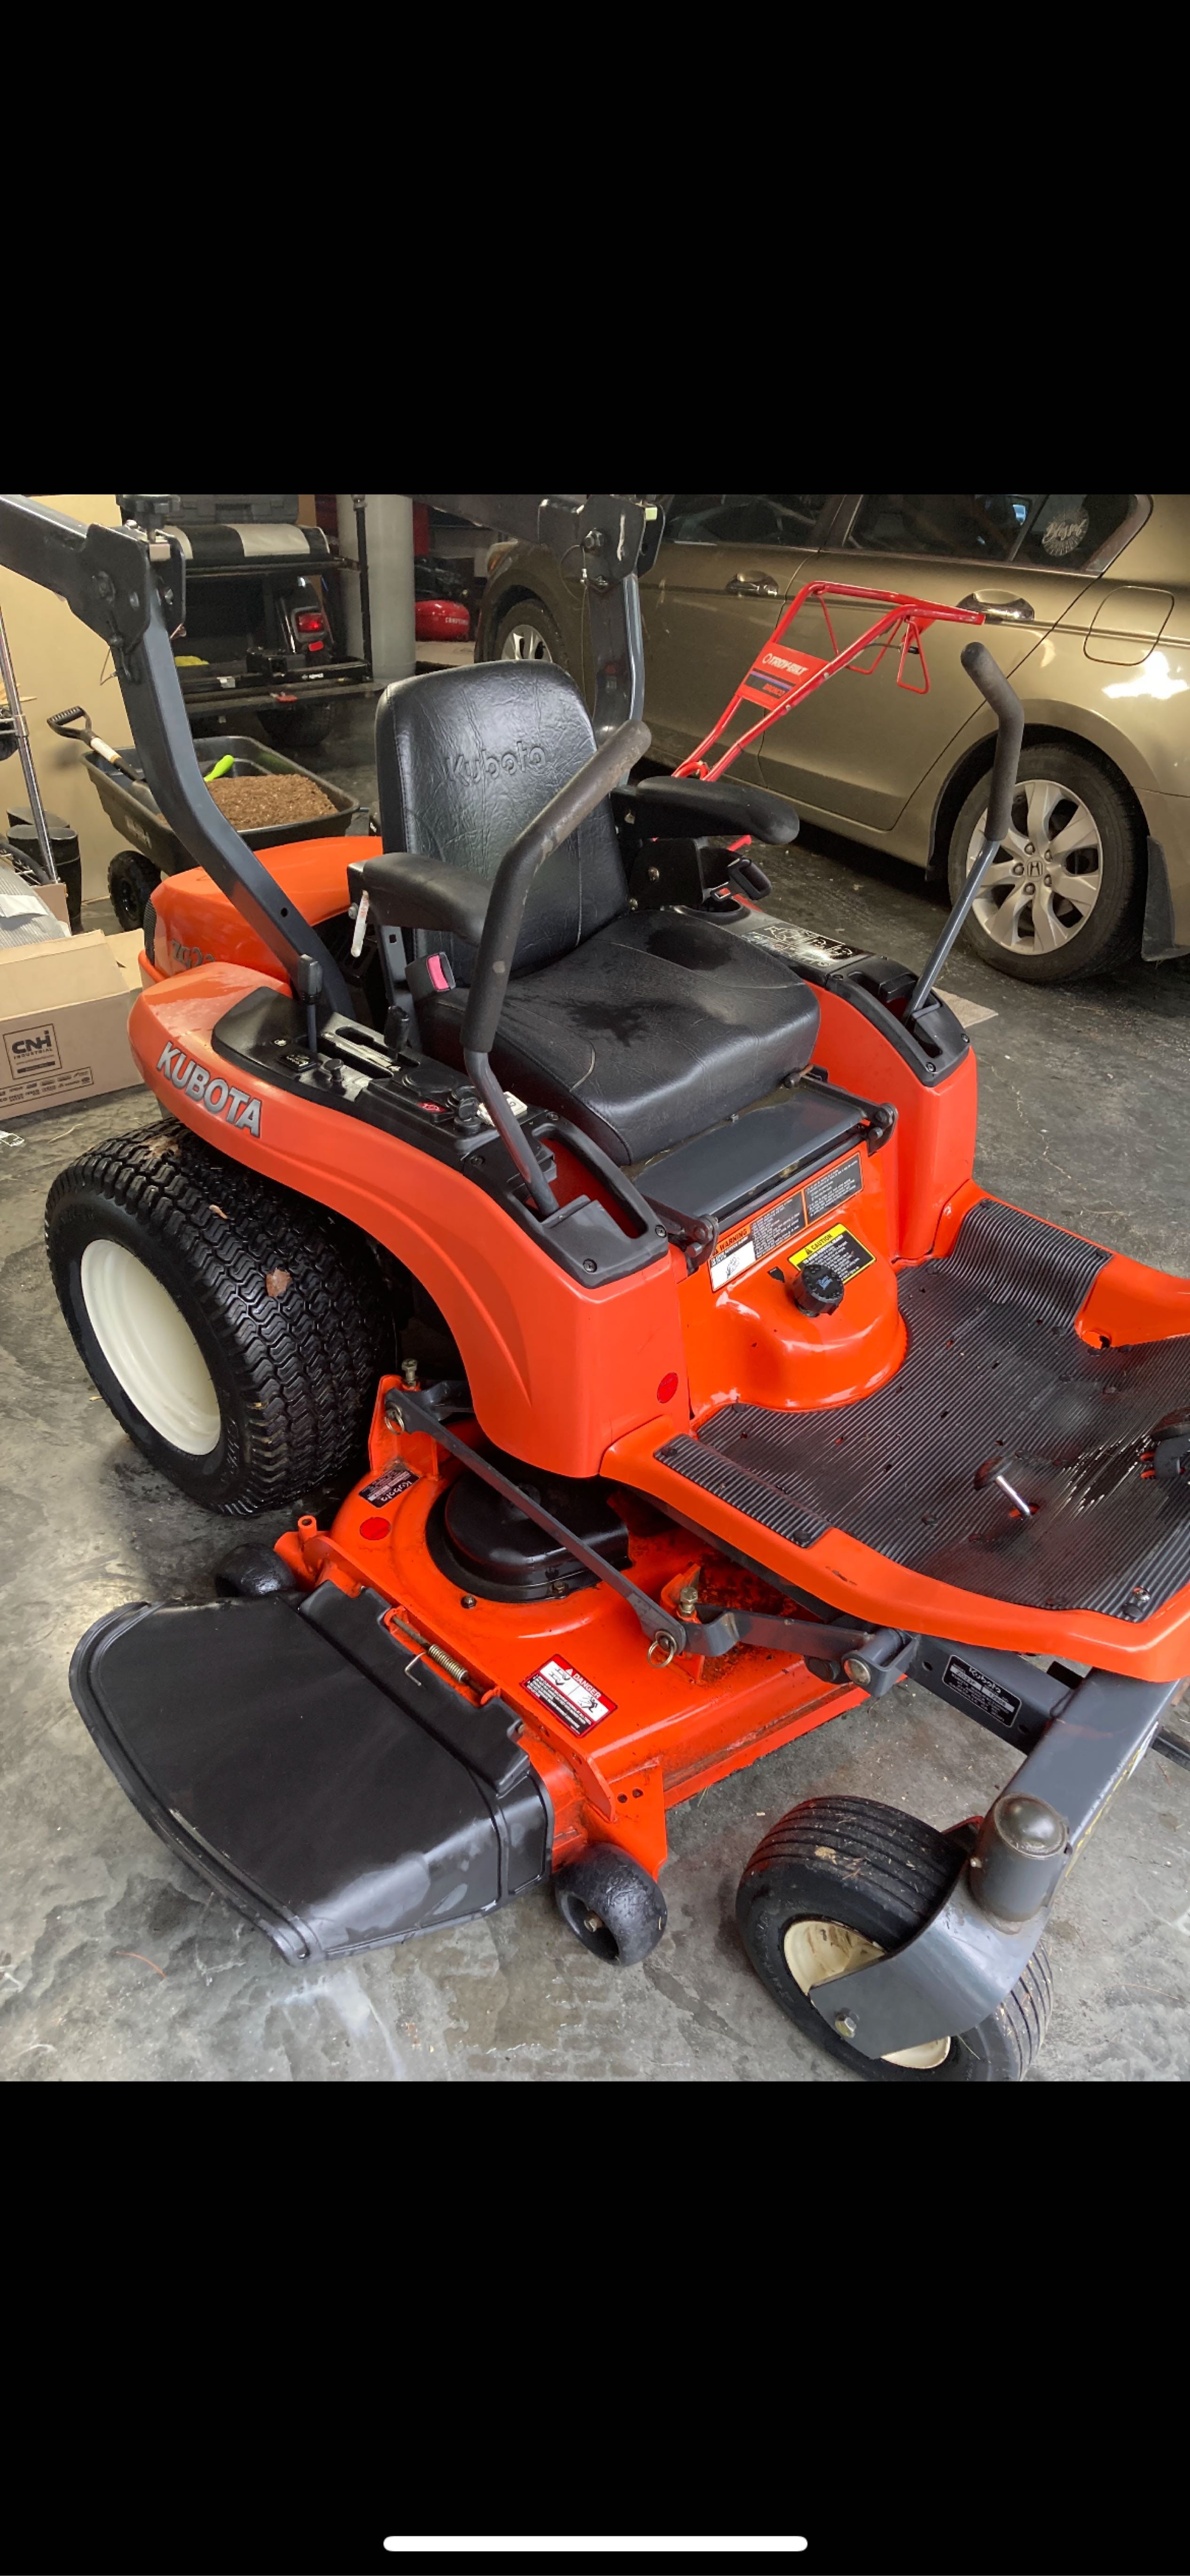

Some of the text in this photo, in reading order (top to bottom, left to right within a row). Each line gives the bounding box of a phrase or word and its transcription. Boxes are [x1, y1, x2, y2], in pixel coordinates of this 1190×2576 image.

[767, 655, 809, 676] TROY-BILT
[446, 741, 546, 786] Kubota
[14, 1047, 53, 1060] INDUSTRIAL
[157, 1040, 263, 1139] KUBOTA
[720, 1228, 748, 1251] WARNING
[811, 1233, 833, 1250] CAUTION
[573, 1673, 602, 1700] DANGER
[969, 1667, 1002, 1693] Kubota
